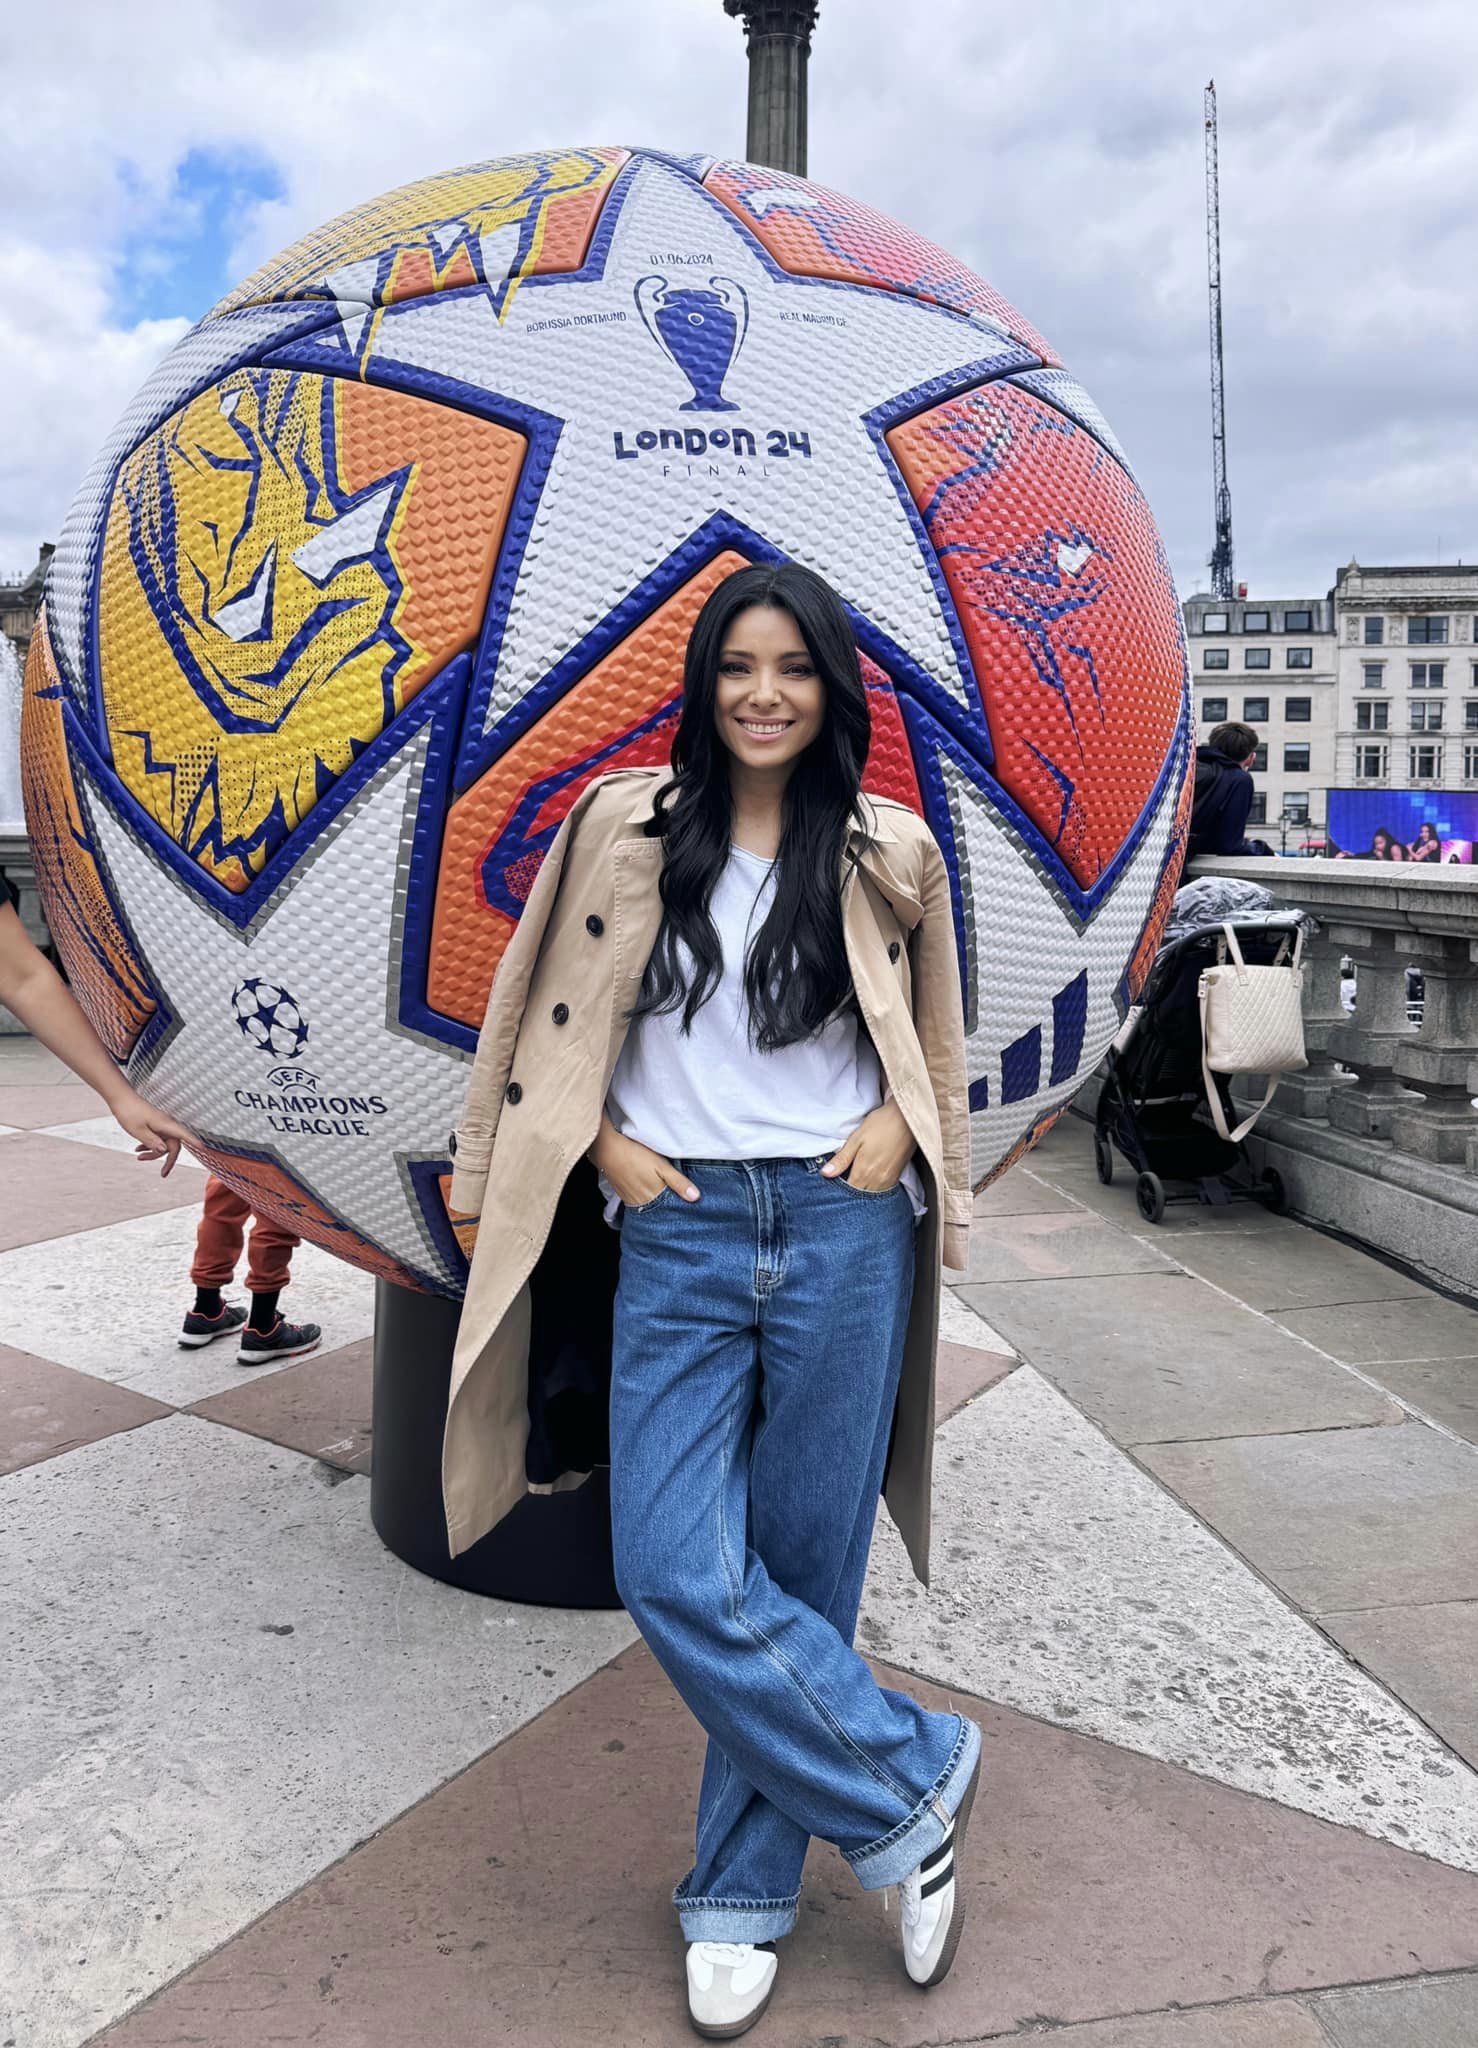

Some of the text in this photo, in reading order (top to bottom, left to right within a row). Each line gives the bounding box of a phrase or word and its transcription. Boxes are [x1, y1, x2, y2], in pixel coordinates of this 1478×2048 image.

[650, 253, 714, 265] 01.06.2024
[526, 311, 627, 332] BORUSSIA DORTMUND
[779, 311, 802, 322] REAL
[766, 430, 812, 458] 24
[663, 465, 770, 477] FINAL
[270, 1070, 318, 1090] UEFA
[234, 1090, 388, 1115] CHAMPIONS
[267, 1115, 370, 1137] LEAGUE
